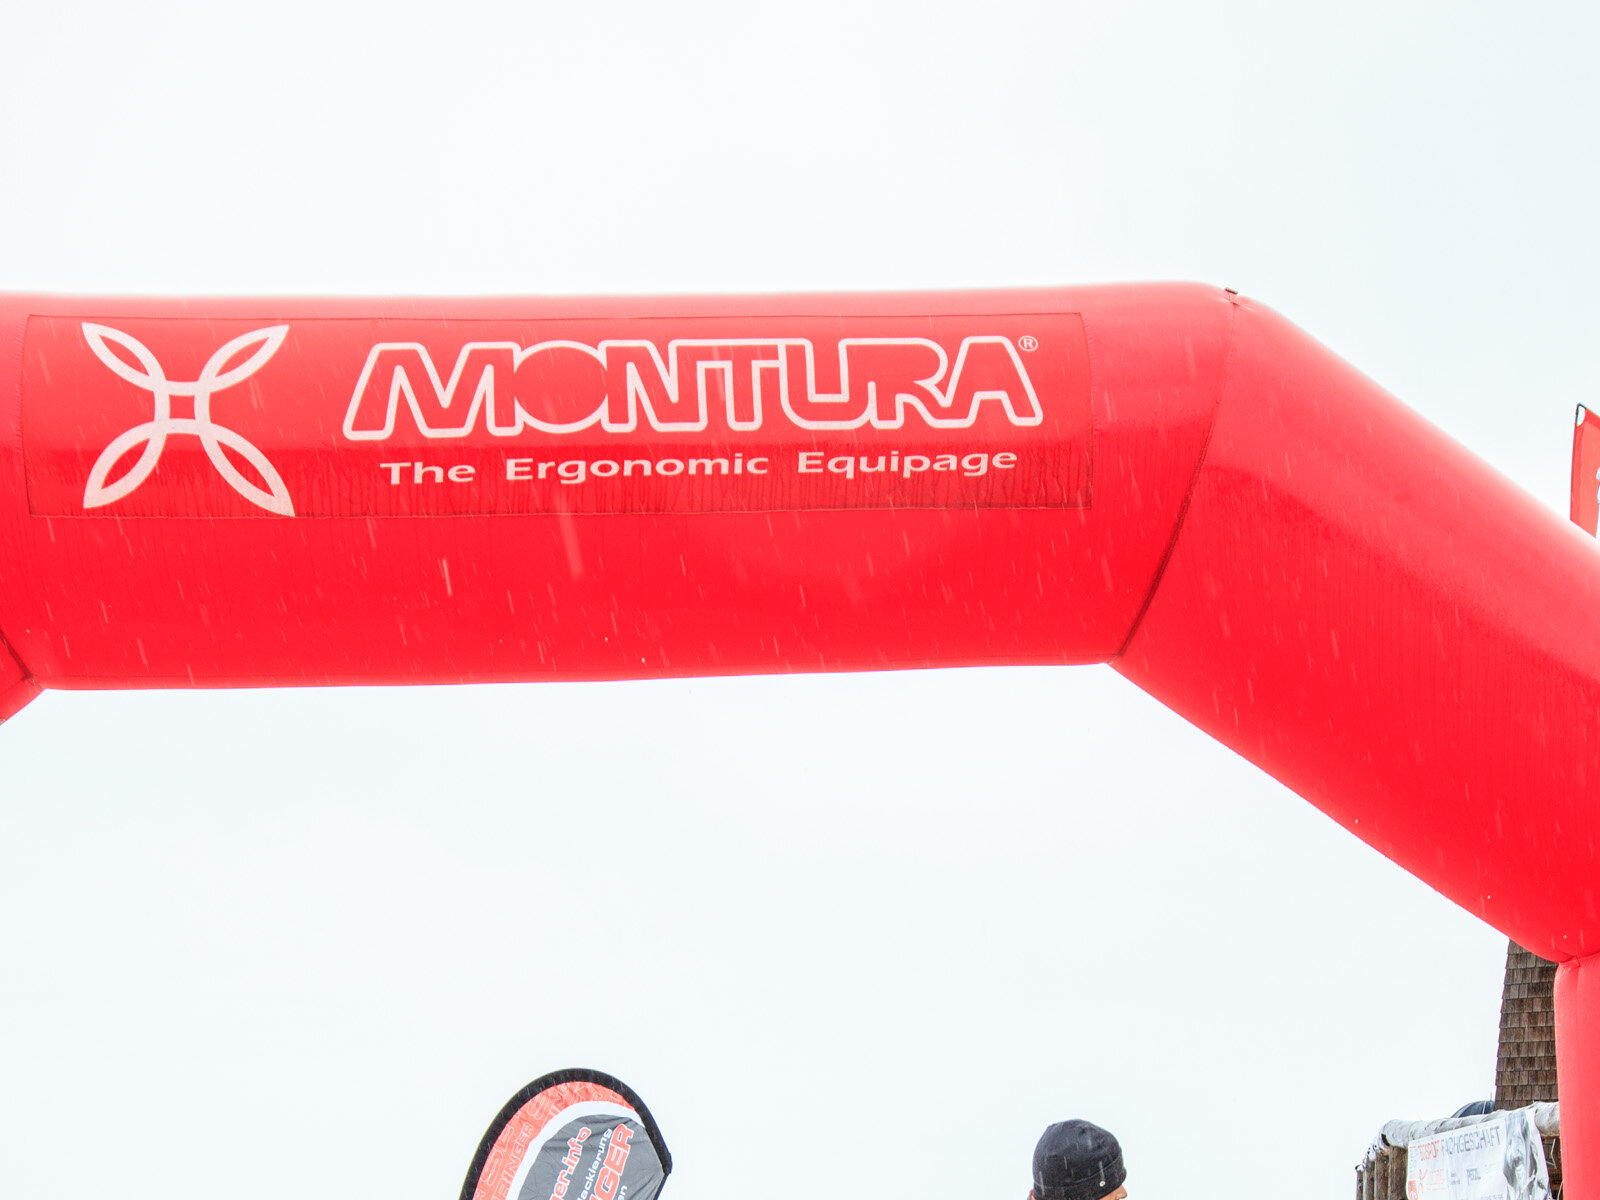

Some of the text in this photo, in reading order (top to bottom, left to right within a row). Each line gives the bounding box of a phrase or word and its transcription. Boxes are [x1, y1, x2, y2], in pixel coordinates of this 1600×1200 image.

[343, 336, 1043, 440] MONTURA
[380, 451, 1018, 485] The Ergonomic Equipage
